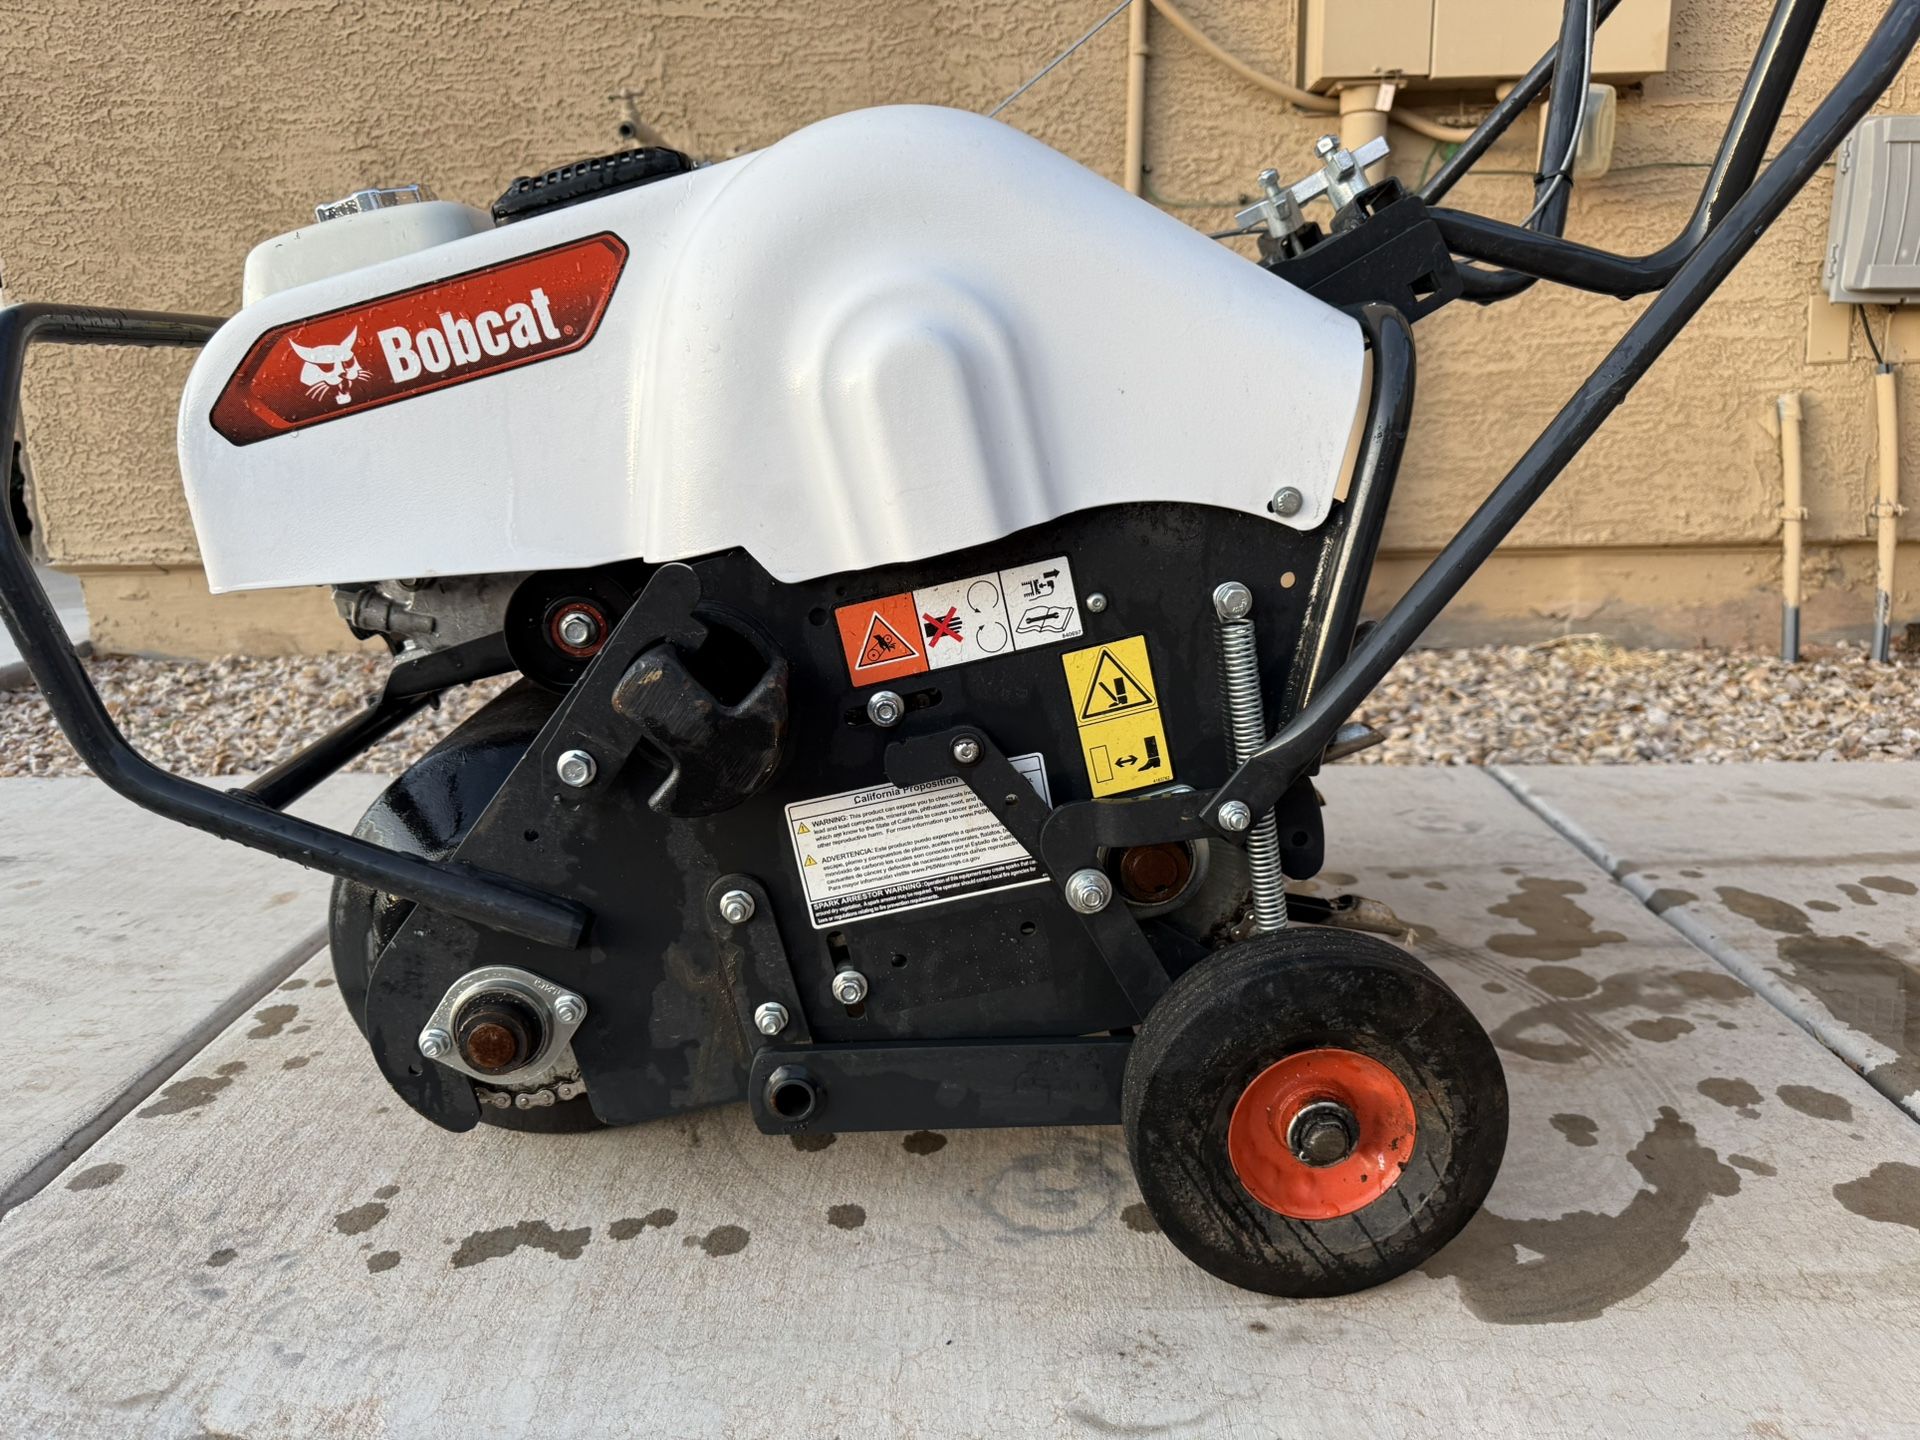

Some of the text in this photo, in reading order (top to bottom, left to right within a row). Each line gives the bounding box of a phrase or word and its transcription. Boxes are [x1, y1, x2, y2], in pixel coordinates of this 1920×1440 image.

[377, 287, 561, 384] Bobcat
[853, 777, 958, 804] California Proposition
[811, 814, 848, 827] WARNING:
[861, 808, 884, 818] product
[934, 792, 963, 801] chemicals
[885, 811, 906, 819] mineral
[897, 815, 923, 824] California
[911, 818, 943, 828] information
[820, 847, 874, 864] ADVERTENCIA:
[887, 841, 913, 850] producto
[813, 899, 840, 910] SPARK
[840, 889, 883, 904] ARRESTOR
